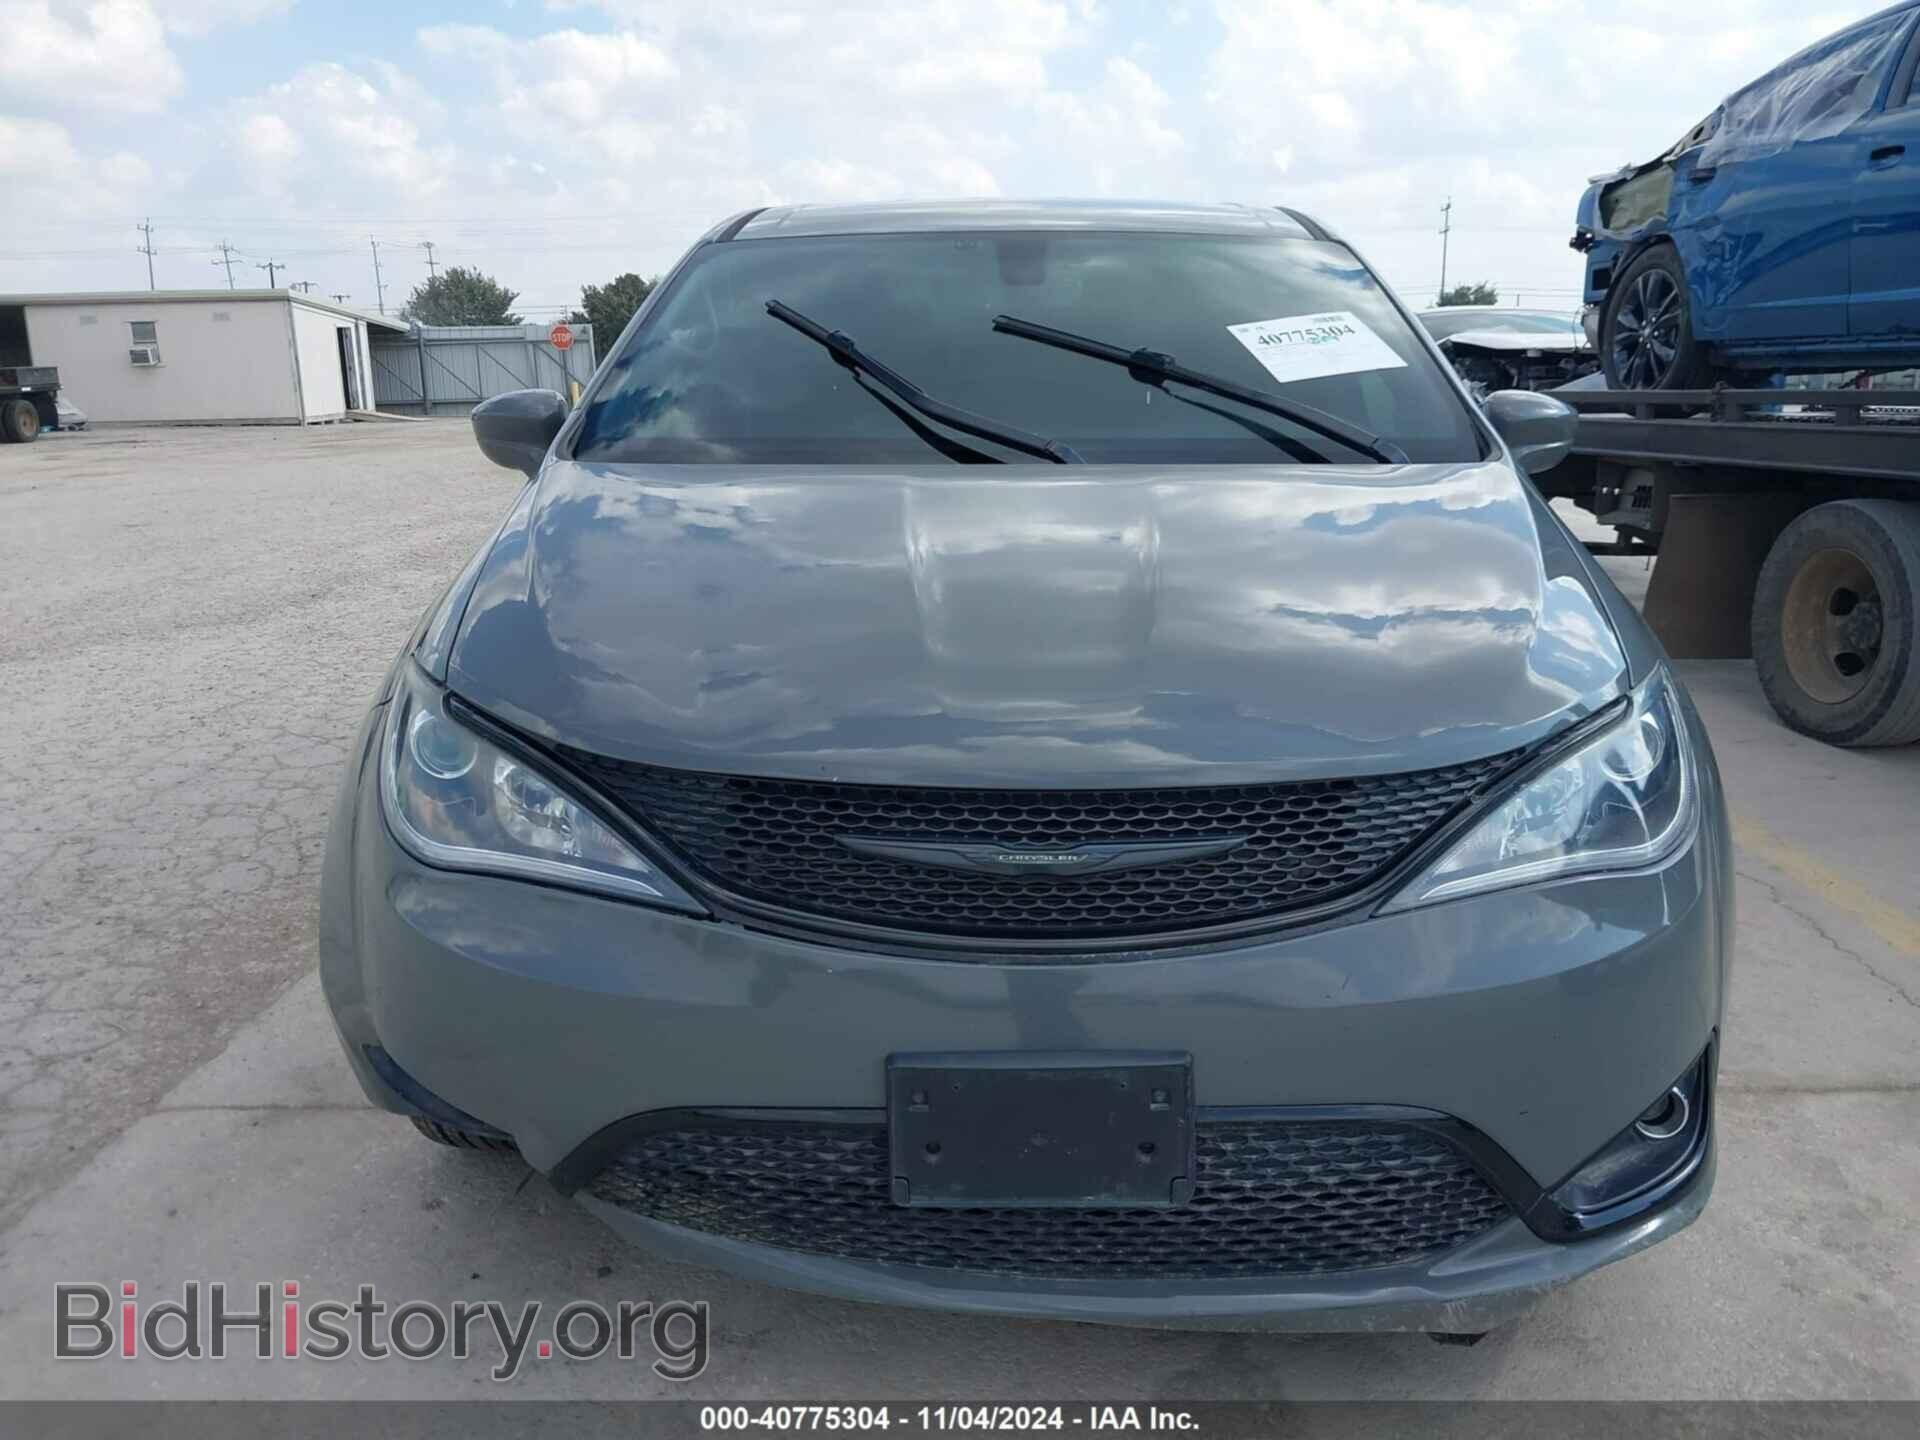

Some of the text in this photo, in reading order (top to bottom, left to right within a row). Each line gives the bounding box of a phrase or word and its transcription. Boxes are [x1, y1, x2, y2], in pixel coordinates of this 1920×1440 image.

[551, 332, 572, 343] STOP
[1256, 324, 1355, 346] 40775304
[999, 854, 1078, 862] CHRYSLER
